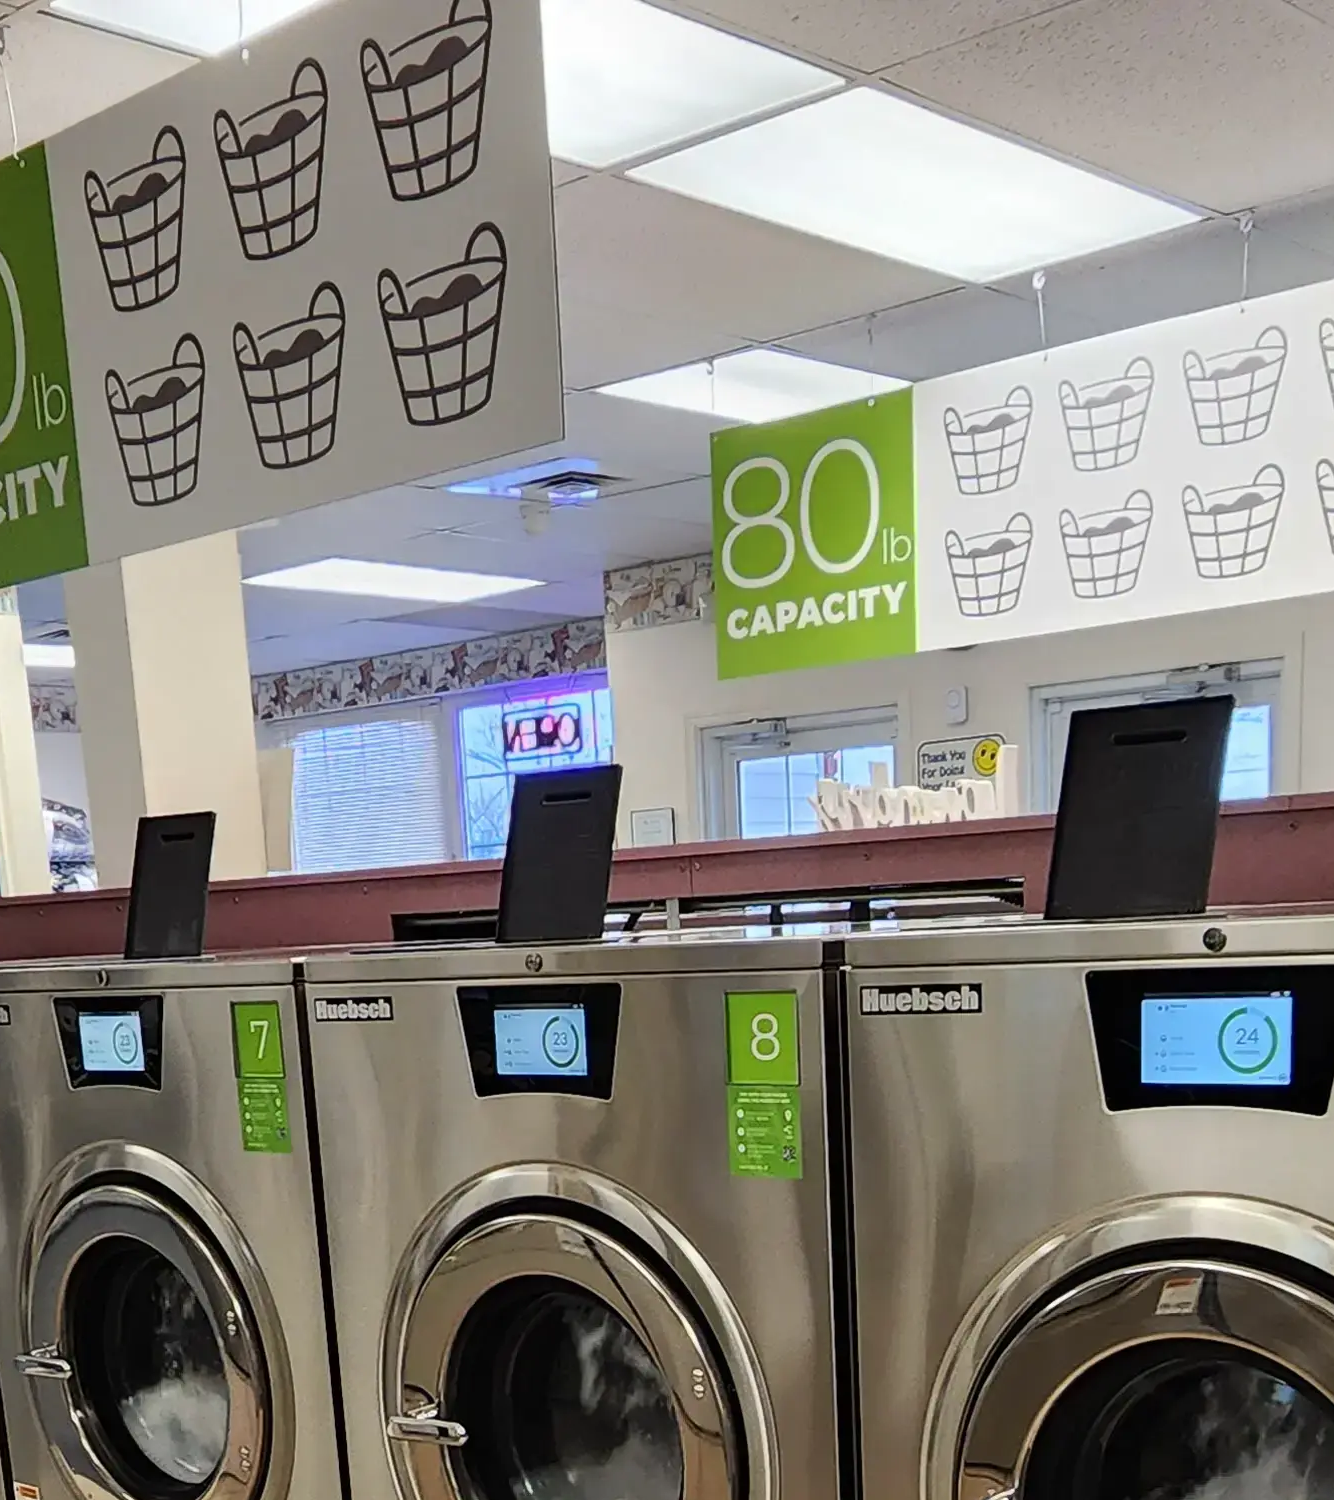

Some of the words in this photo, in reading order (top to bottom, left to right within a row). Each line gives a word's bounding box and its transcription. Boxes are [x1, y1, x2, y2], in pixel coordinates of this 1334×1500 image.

[32, 374, 66, 431] lb
[721, 438, 880, 590] 80
[882, 527, 912, 565] lb
[727, 580, 908, 640] CAPACITY
[921, 766, 938, 779] For
[315, 998, 391, 1020] Huebsch
[861, 985, 980, 1013] Huebsch
[250, 1020, 270, 1060] 7
[553, 1031, 568, 1046] 23
[750, 1012, 781, 1062] 8
[1235, 1027, 1260, 1045] 24
